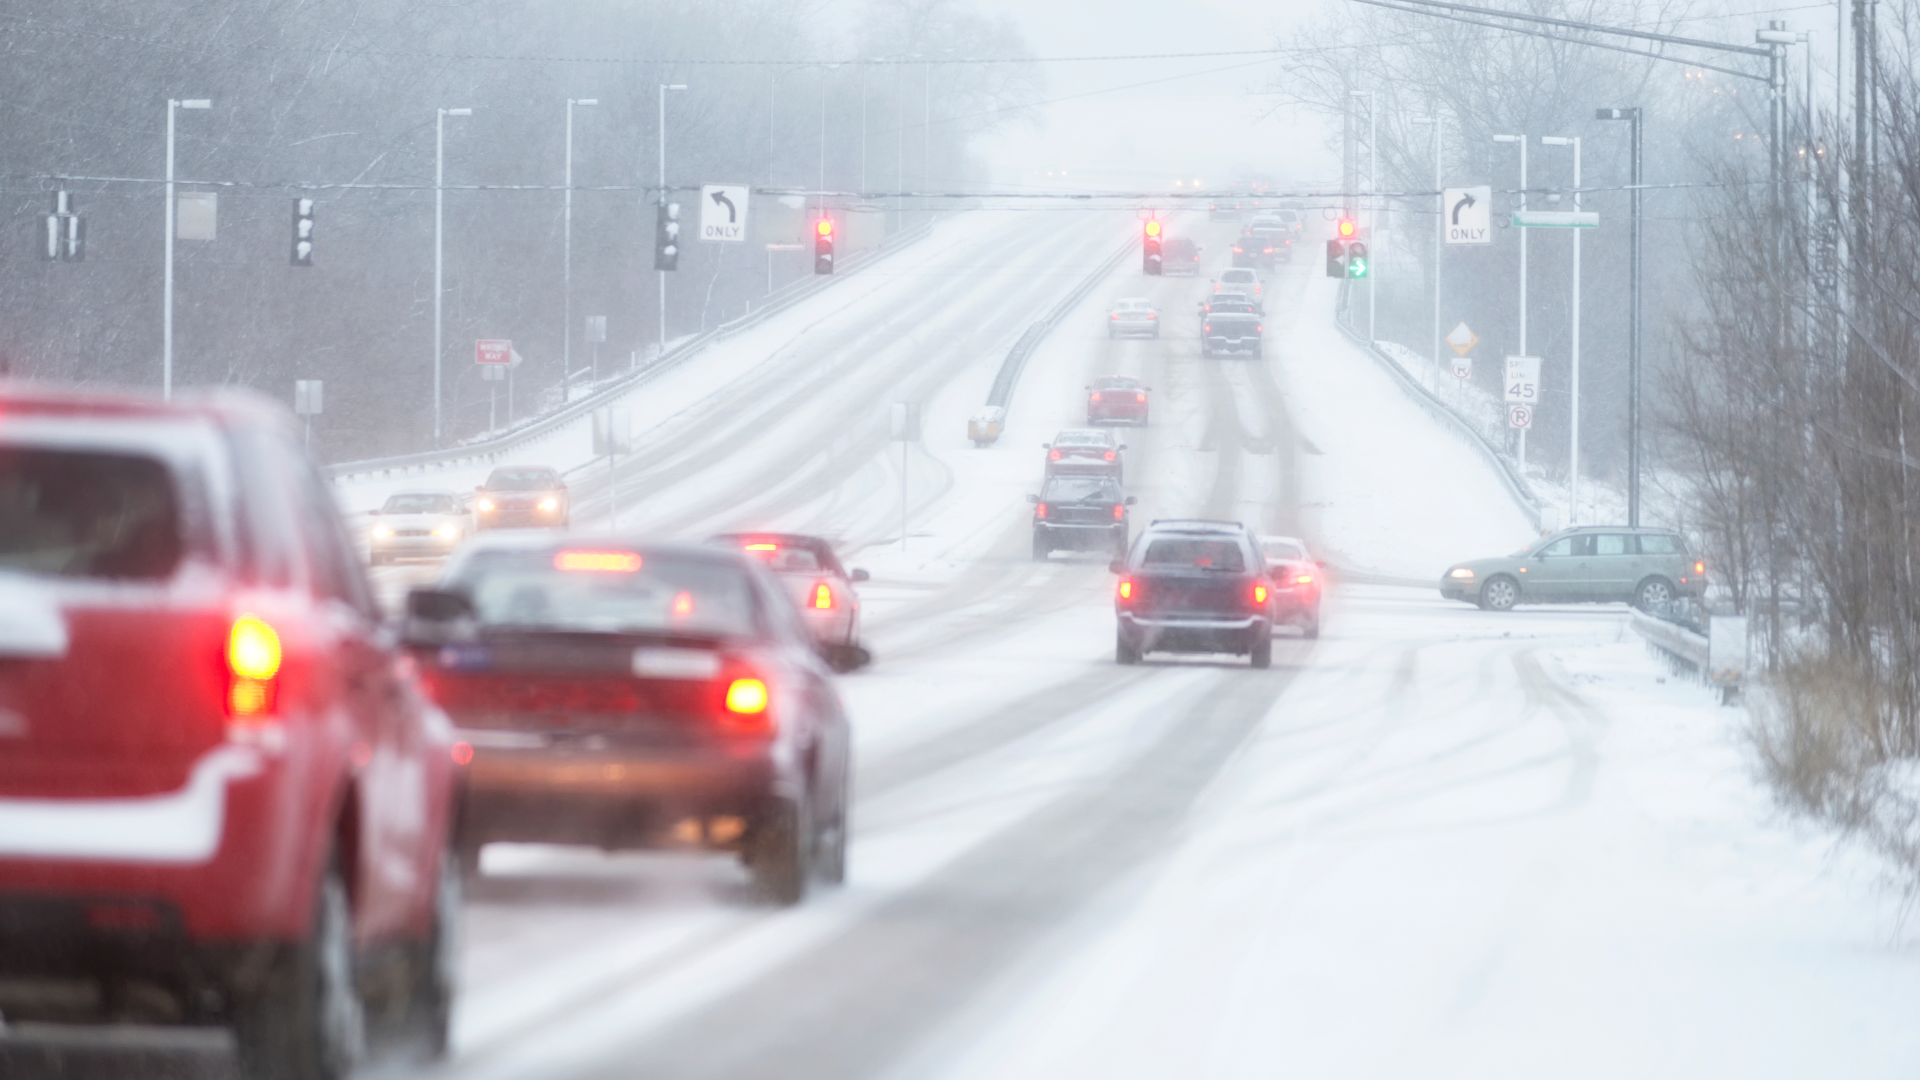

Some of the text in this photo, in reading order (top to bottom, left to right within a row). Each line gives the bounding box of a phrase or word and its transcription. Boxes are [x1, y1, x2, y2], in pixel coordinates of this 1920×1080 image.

[706, 225, 740, 237] ONLY
[1451, 228, 1485, 240] ONLY
[485, 352, 502, 360] WAY
[1508, 383, 1535, 398] 45
